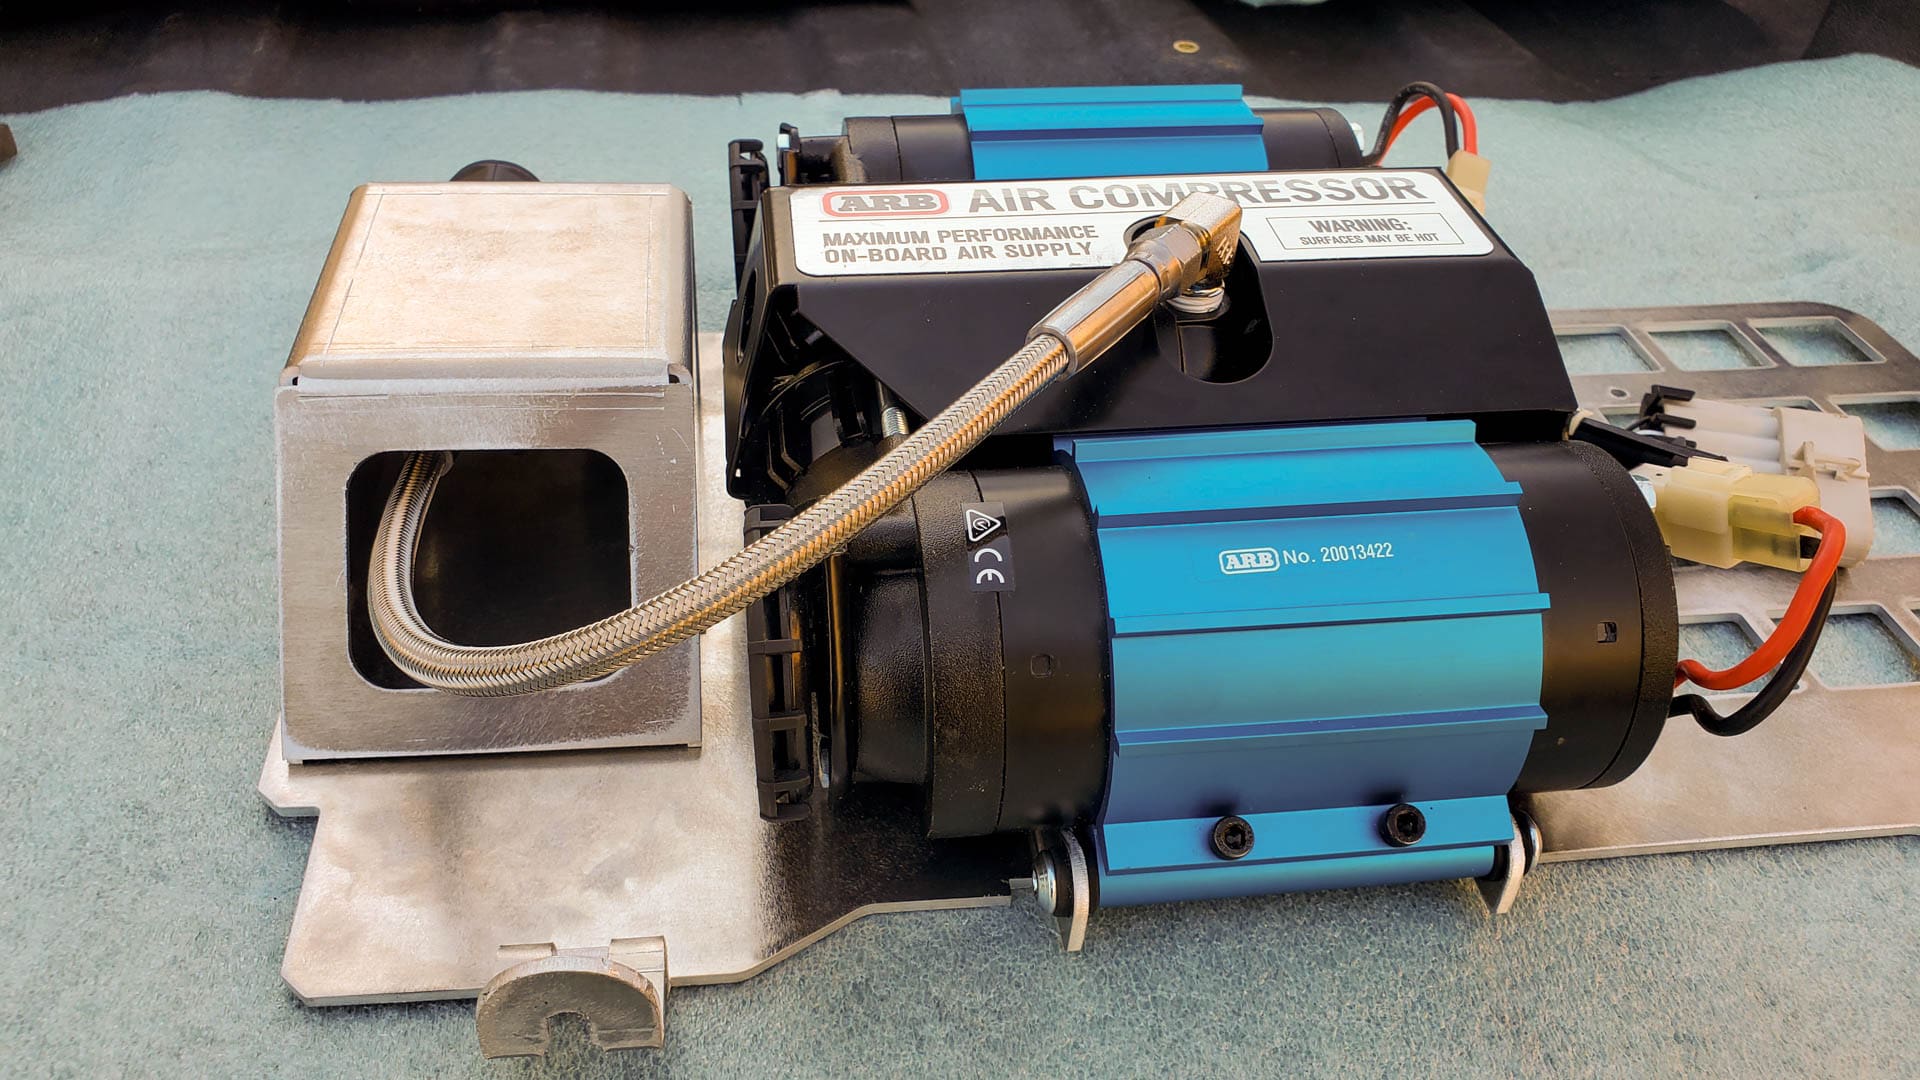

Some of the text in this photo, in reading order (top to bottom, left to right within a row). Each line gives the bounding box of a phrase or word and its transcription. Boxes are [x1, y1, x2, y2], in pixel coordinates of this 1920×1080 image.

[838, 194, 938, 211] ARB
[968, 187, 1056, 213] AIR
[822, 225, 1099, 247] MAXIMUM PERFORMANCE
[1308, 218, 1412, 233] WARNING:
[1300, 232, 1440, 246] SURFACES MAY BE HOT
[824, 241, 1093, 263] ON-BOARD AIR SUPPLY
[1226, 542, 1394, 570] ARB No. 20013422
